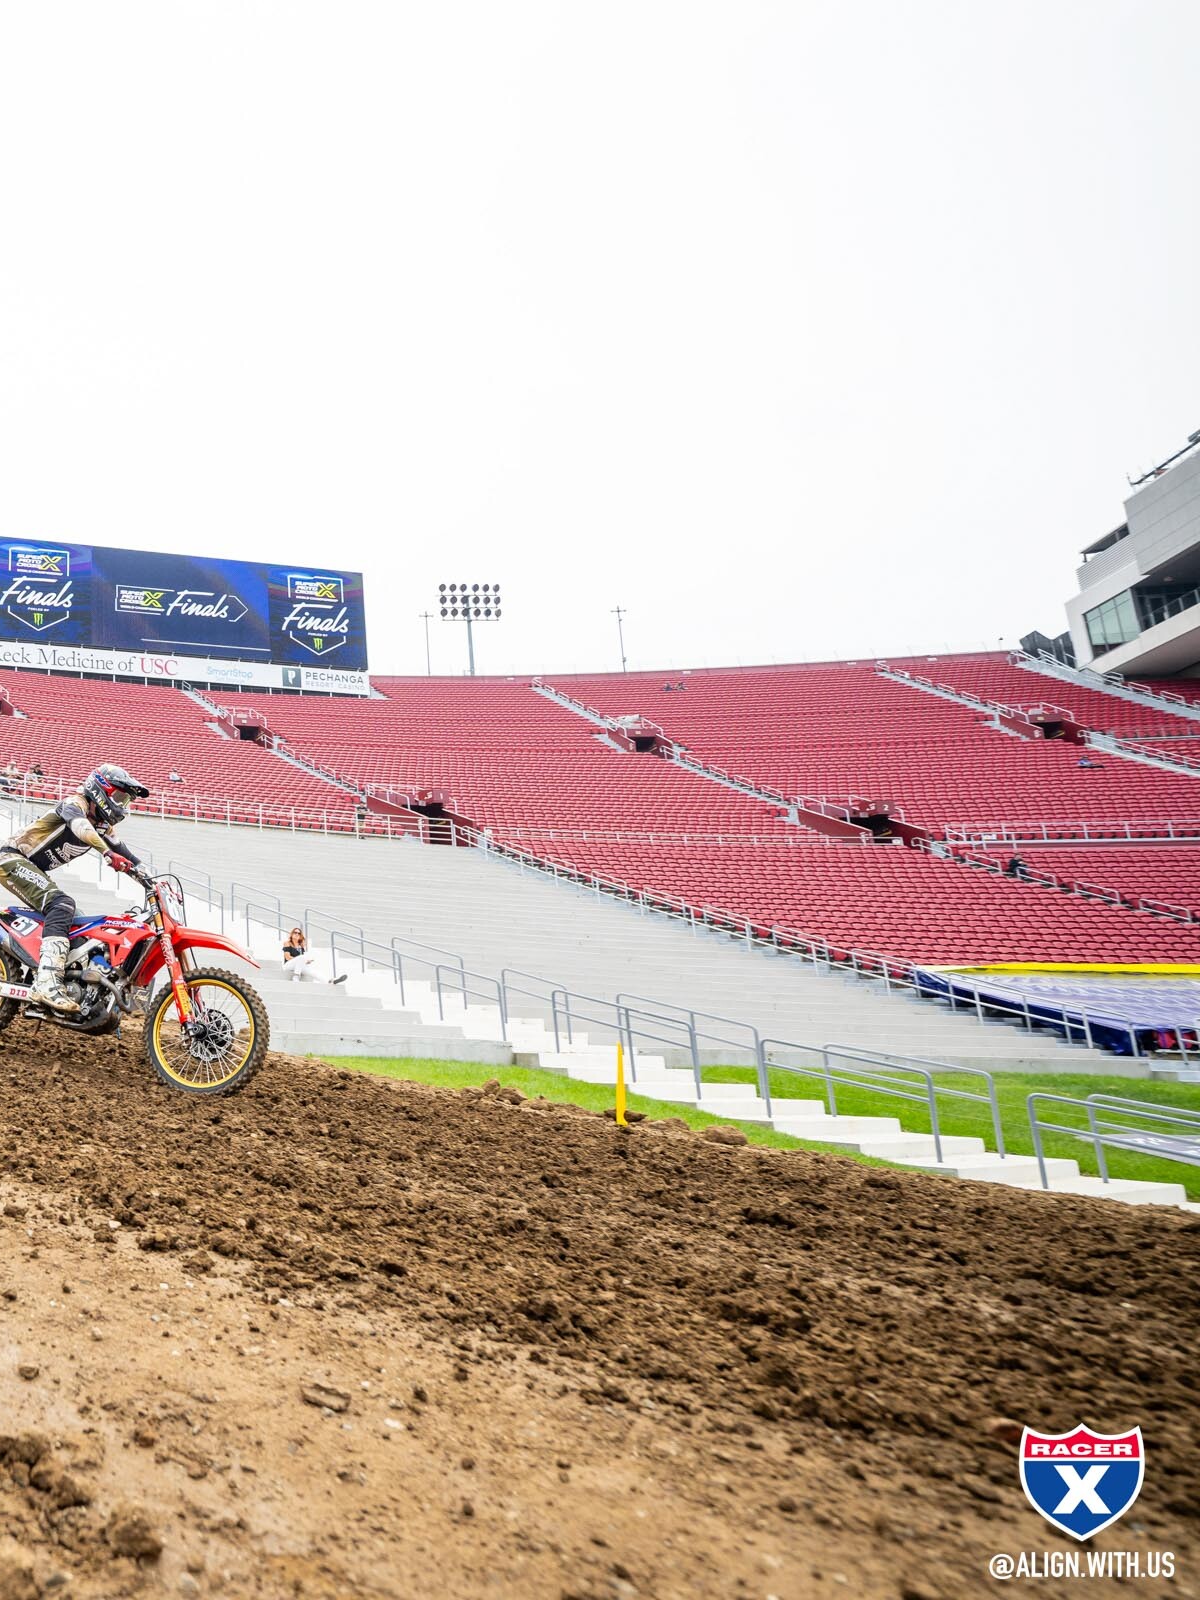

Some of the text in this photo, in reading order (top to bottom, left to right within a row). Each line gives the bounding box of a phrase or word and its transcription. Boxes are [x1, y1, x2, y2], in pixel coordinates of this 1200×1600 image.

[0, 575, 74, 607] Finals
[166, 589, 229, 618] Finals
[281, 602, 349, 633] Finals
[37, 648, 114, 671] Medicine
[117, 656, 137, 673] of
[140, 657, 179, 676] USC
[305, 671, 364, 684] PECHANGA
[338, 683, 366, 691] CASINO
[9, 988, 28, 998] DID
